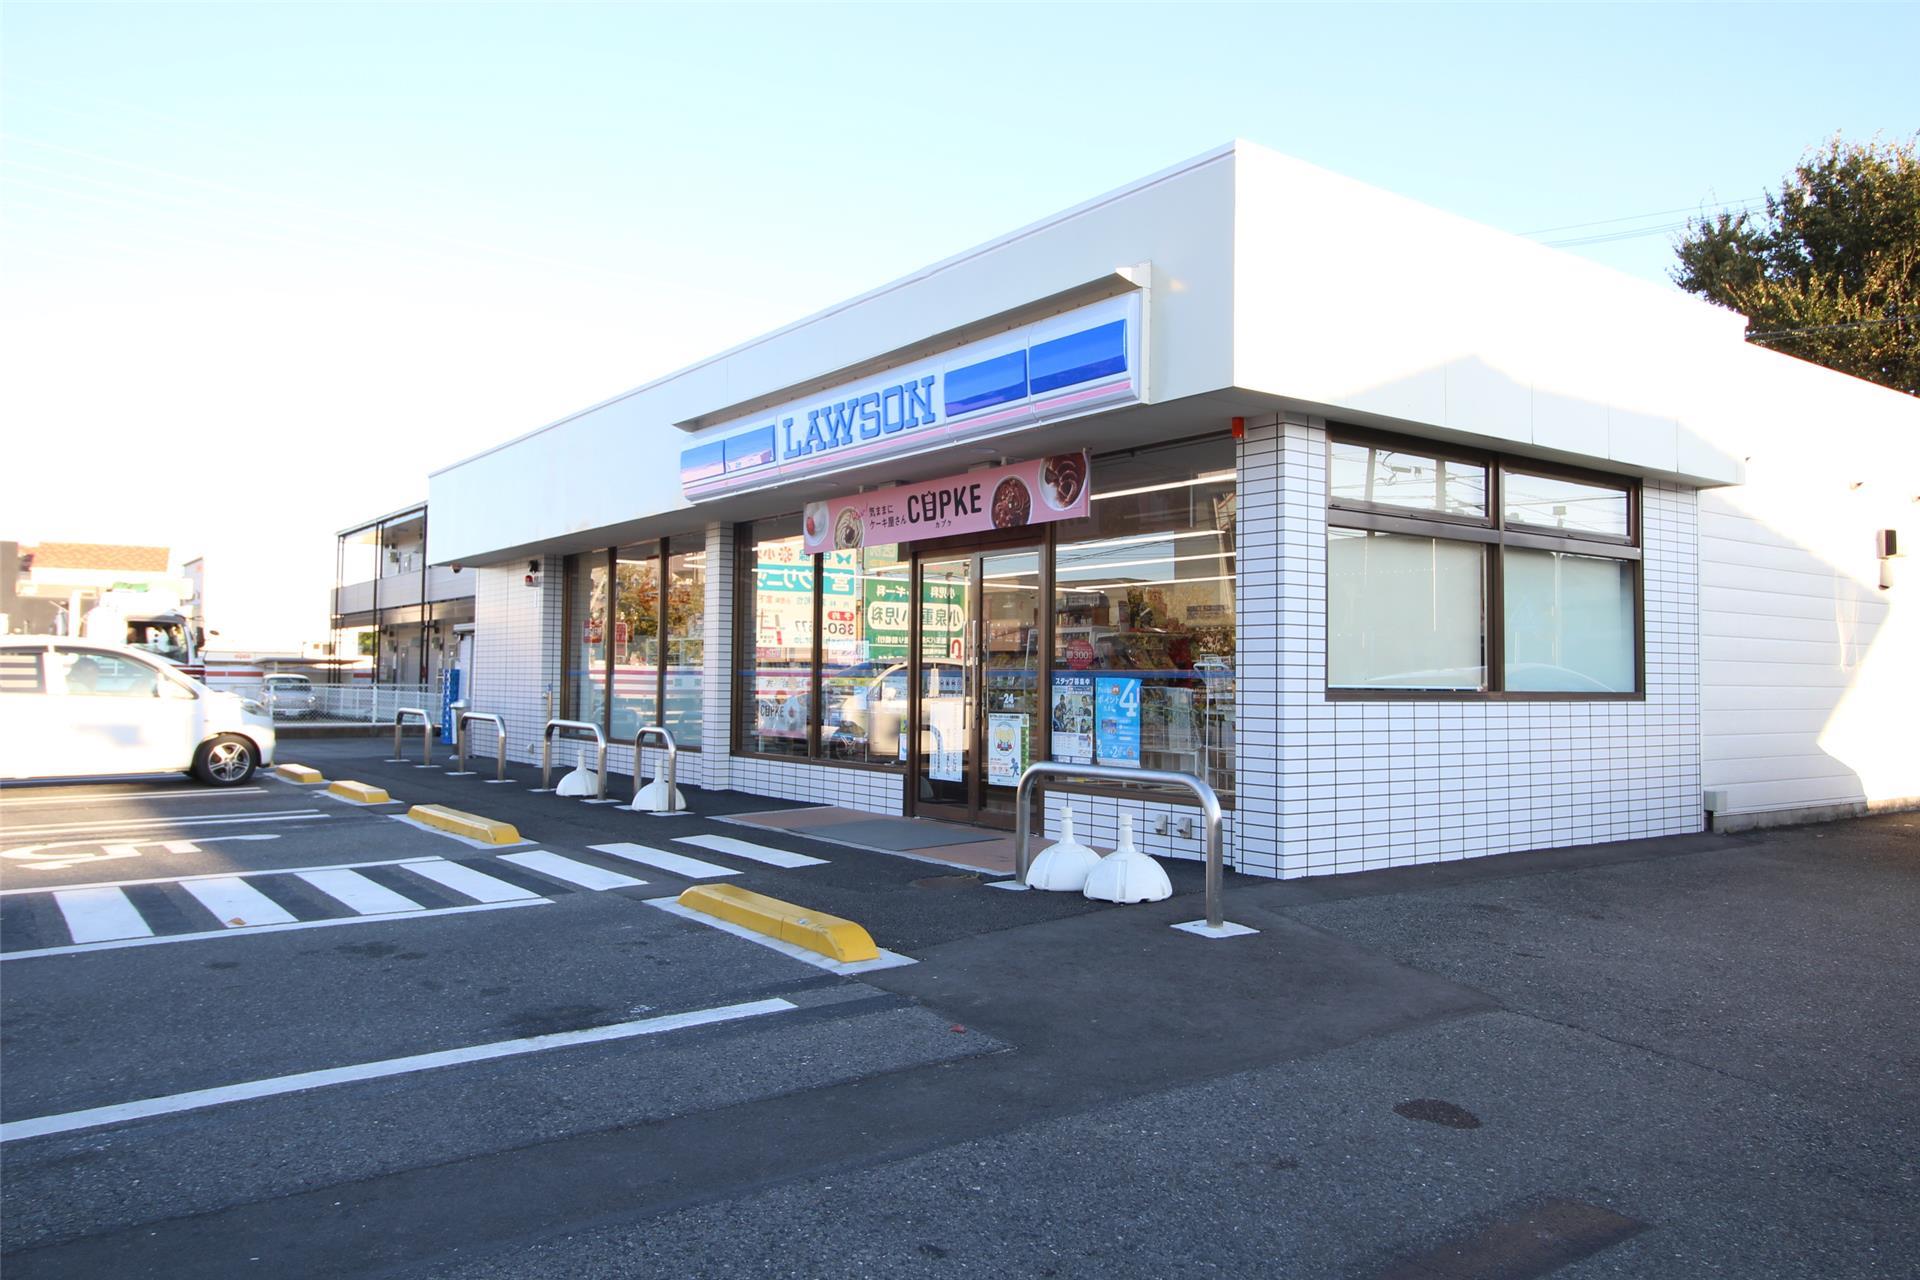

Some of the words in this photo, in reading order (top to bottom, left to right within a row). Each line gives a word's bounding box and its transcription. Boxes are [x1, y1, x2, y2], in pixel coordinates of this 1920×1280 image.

[783, 376, 936, 460] LAWSON
[907, 484, 982, 523] CUPKE
[869, 505, 894, 518] 気ままに
[869, 515, 908, 530] ケーキ屋さん
[1003, 693, 1014, 704] 24
